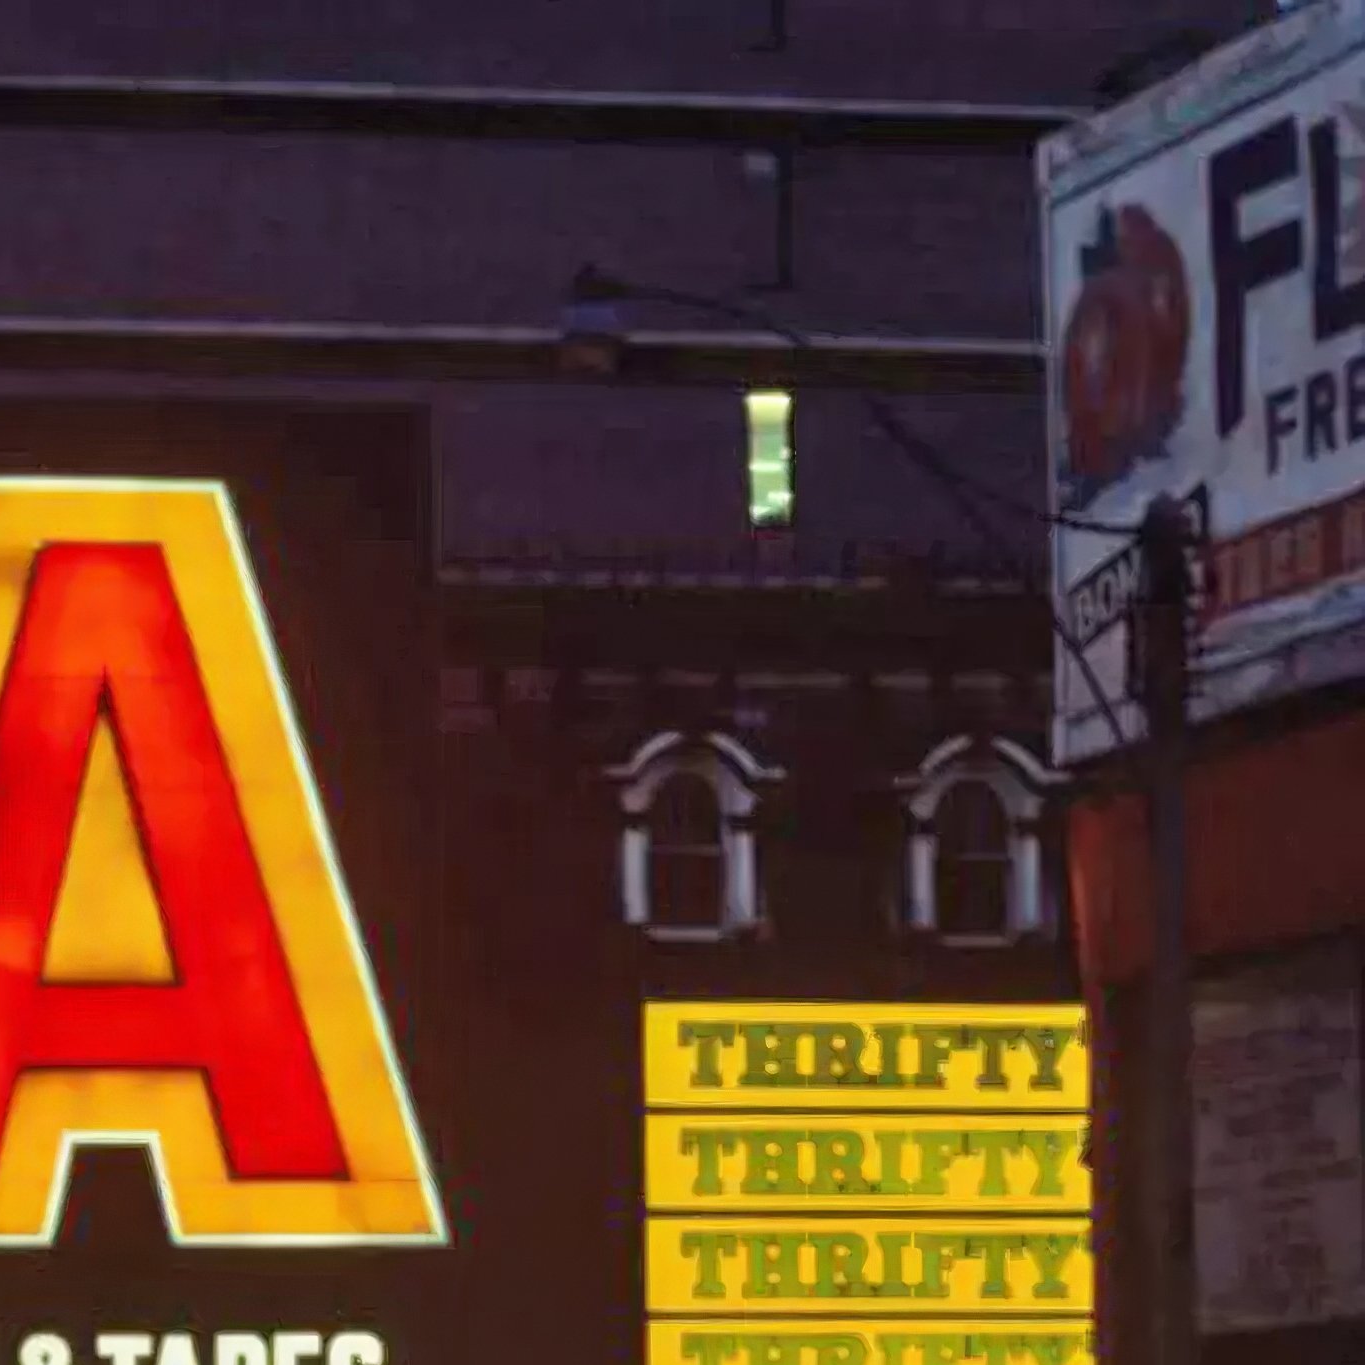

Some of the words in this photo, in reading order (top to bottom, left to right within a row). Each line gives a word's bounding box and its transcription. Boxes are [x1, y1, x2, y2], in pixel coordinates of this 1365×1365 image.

[679, 1022, 1076, 1090] THRIFTY
[681, 1130, 1078, 1195] THRIFTY
[681, 1233, 1079, 1298] THRIFTY
